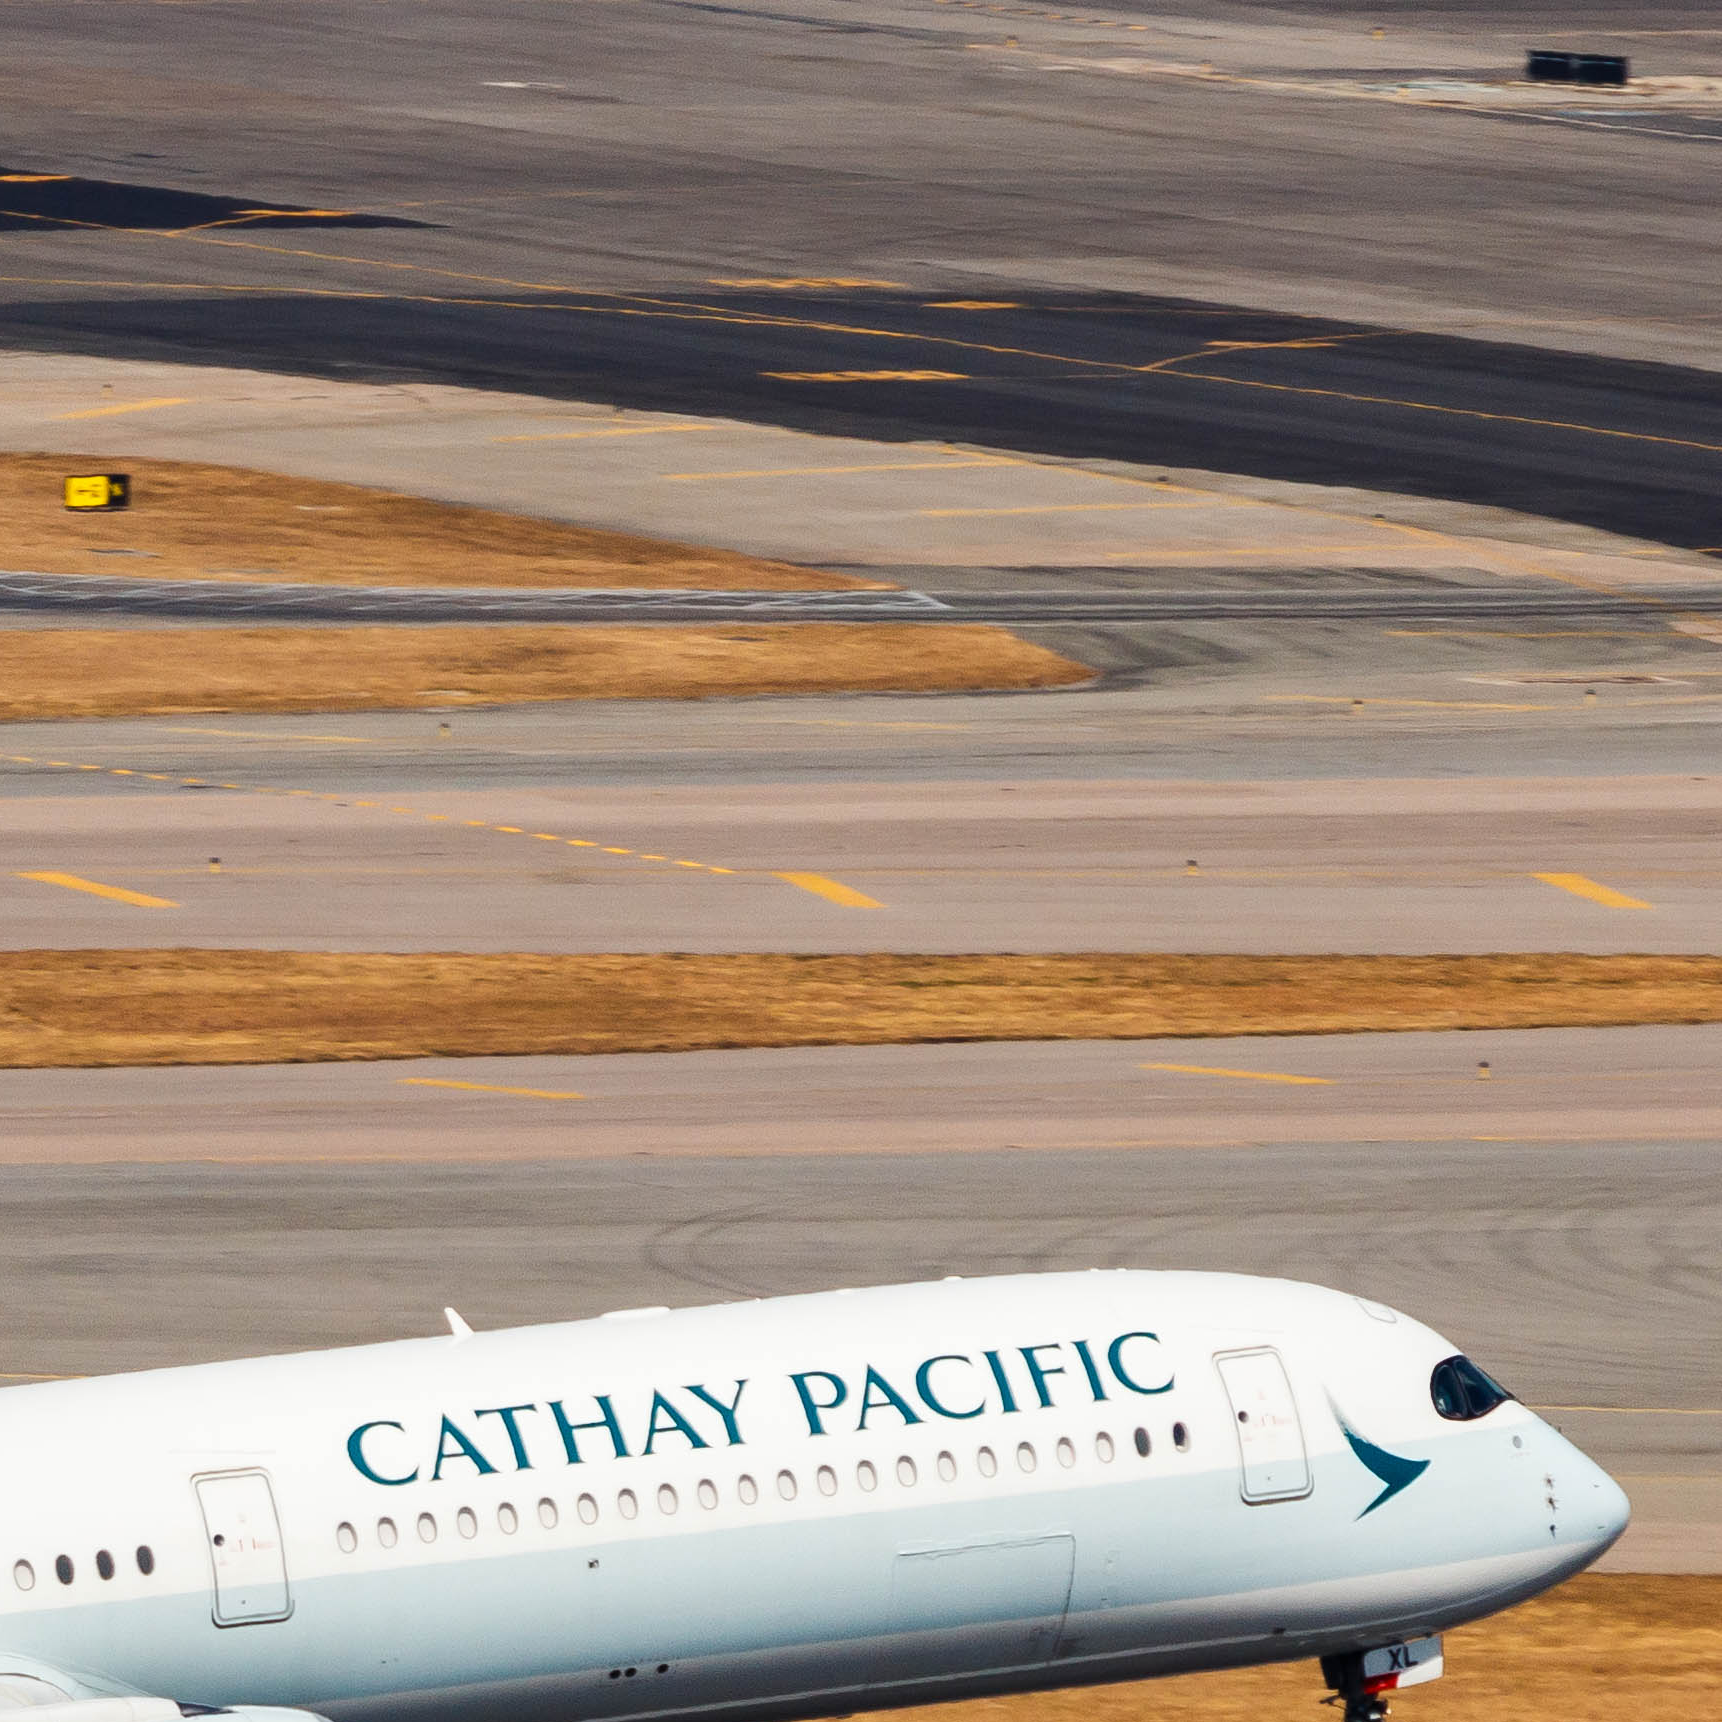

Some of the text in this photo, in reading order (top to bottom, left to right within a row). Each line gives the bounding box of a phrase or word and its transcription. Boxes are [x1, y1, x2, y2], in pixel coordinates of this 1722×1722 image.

[347, 1378, 749, 1486] CATHAY
[787, 1331, 1176, 1437] PACIFIC
[1388, 1646, 1419, 1671] XL
